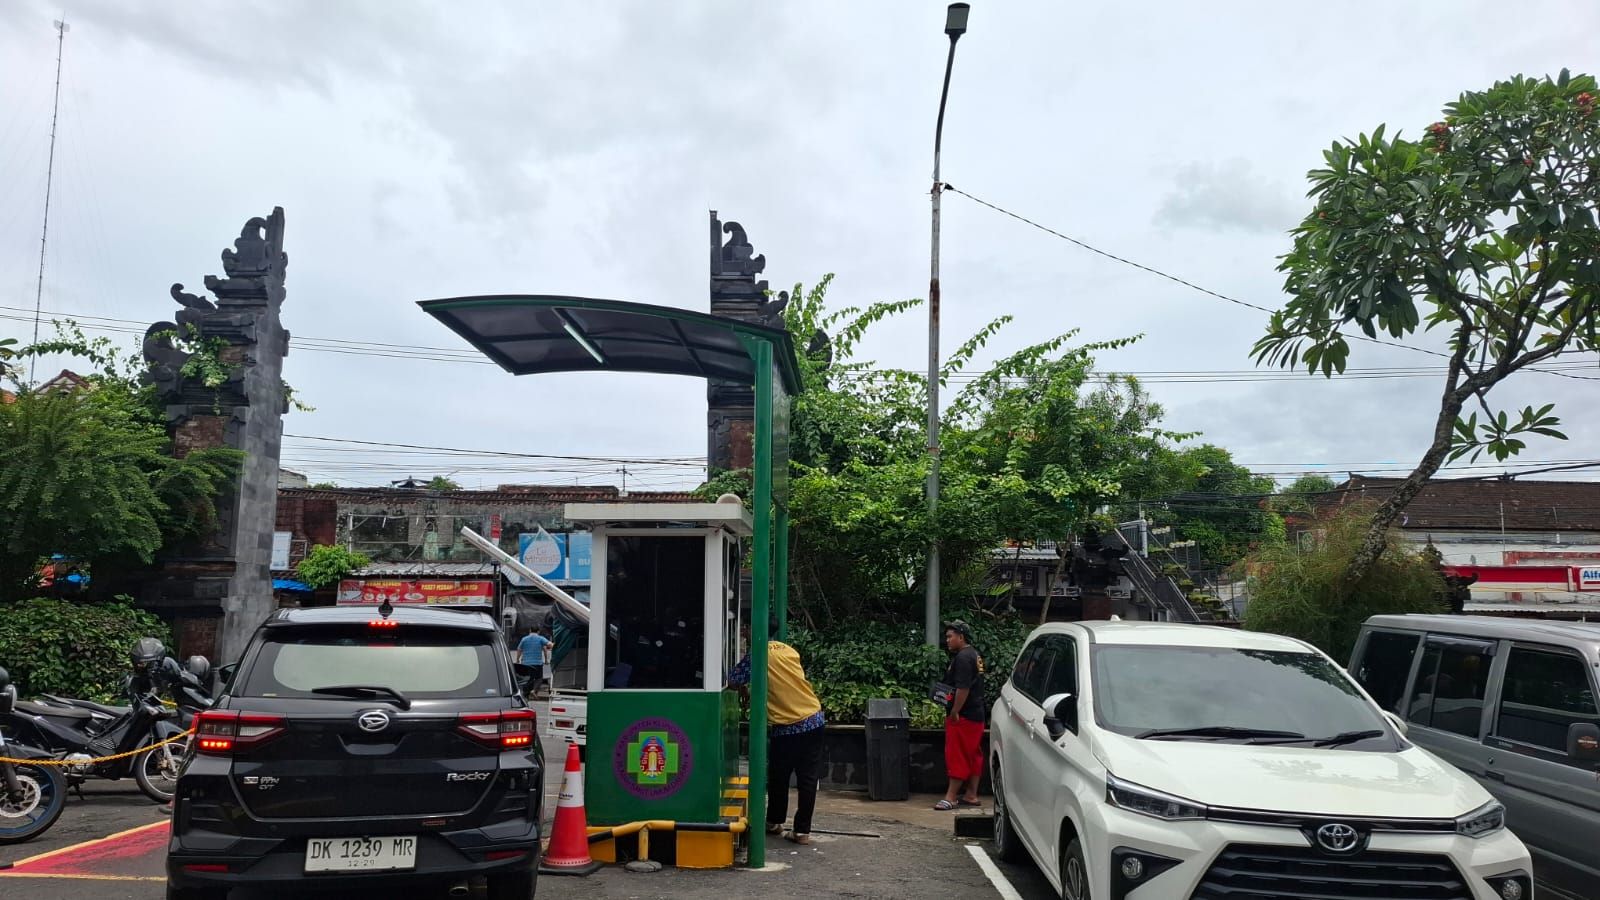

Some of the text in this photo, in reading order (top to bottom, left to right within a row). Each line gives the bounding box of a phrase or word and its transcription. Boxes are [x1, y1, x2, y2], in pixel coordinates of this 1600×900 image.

[446, 771, 491, 782] Rocky
[310, 838, 413, 859] DK 1239 MR
